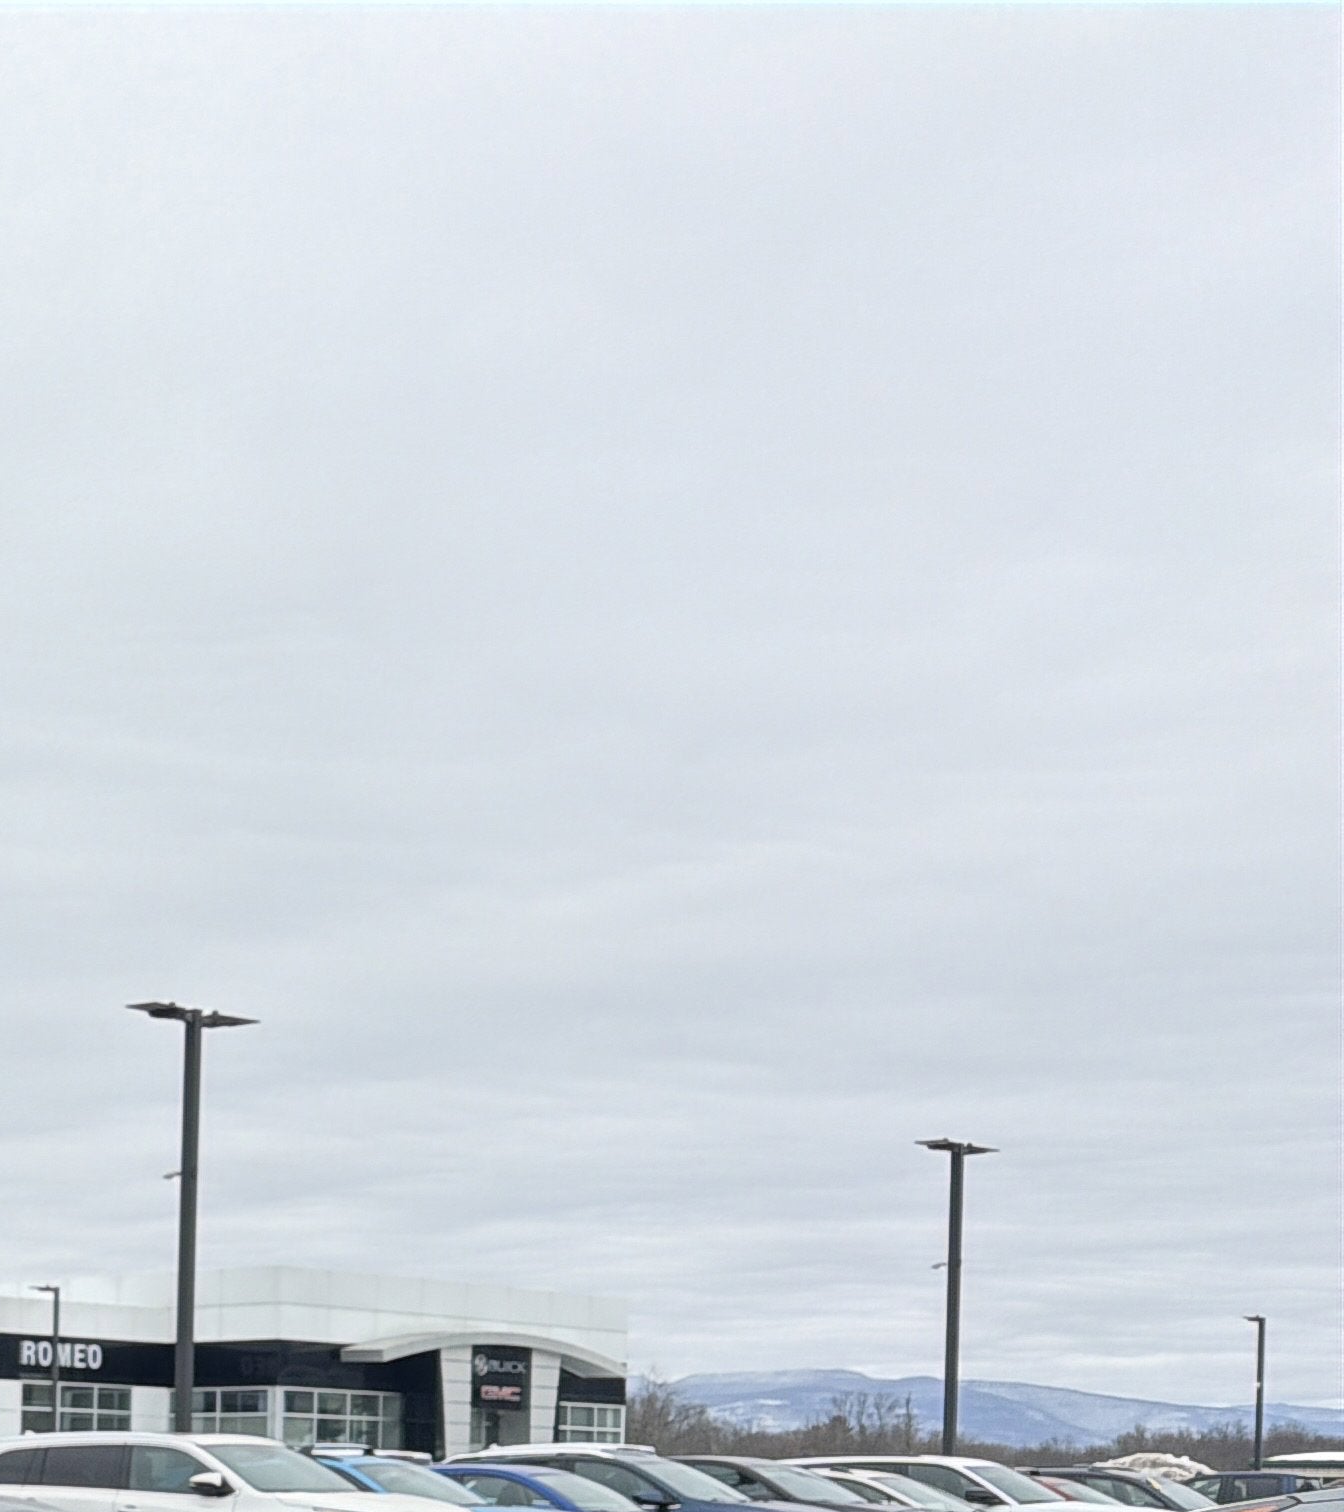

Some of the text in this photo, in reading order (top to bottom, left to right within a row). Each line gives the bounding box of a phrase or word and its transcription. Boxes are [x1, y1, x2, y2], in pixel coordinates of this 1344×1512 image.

[20, 1339, 103, 1370] ROMEO
[487, 1359, 527, 1375] BUICK
[480, 1384, 523, 1402] GMC
